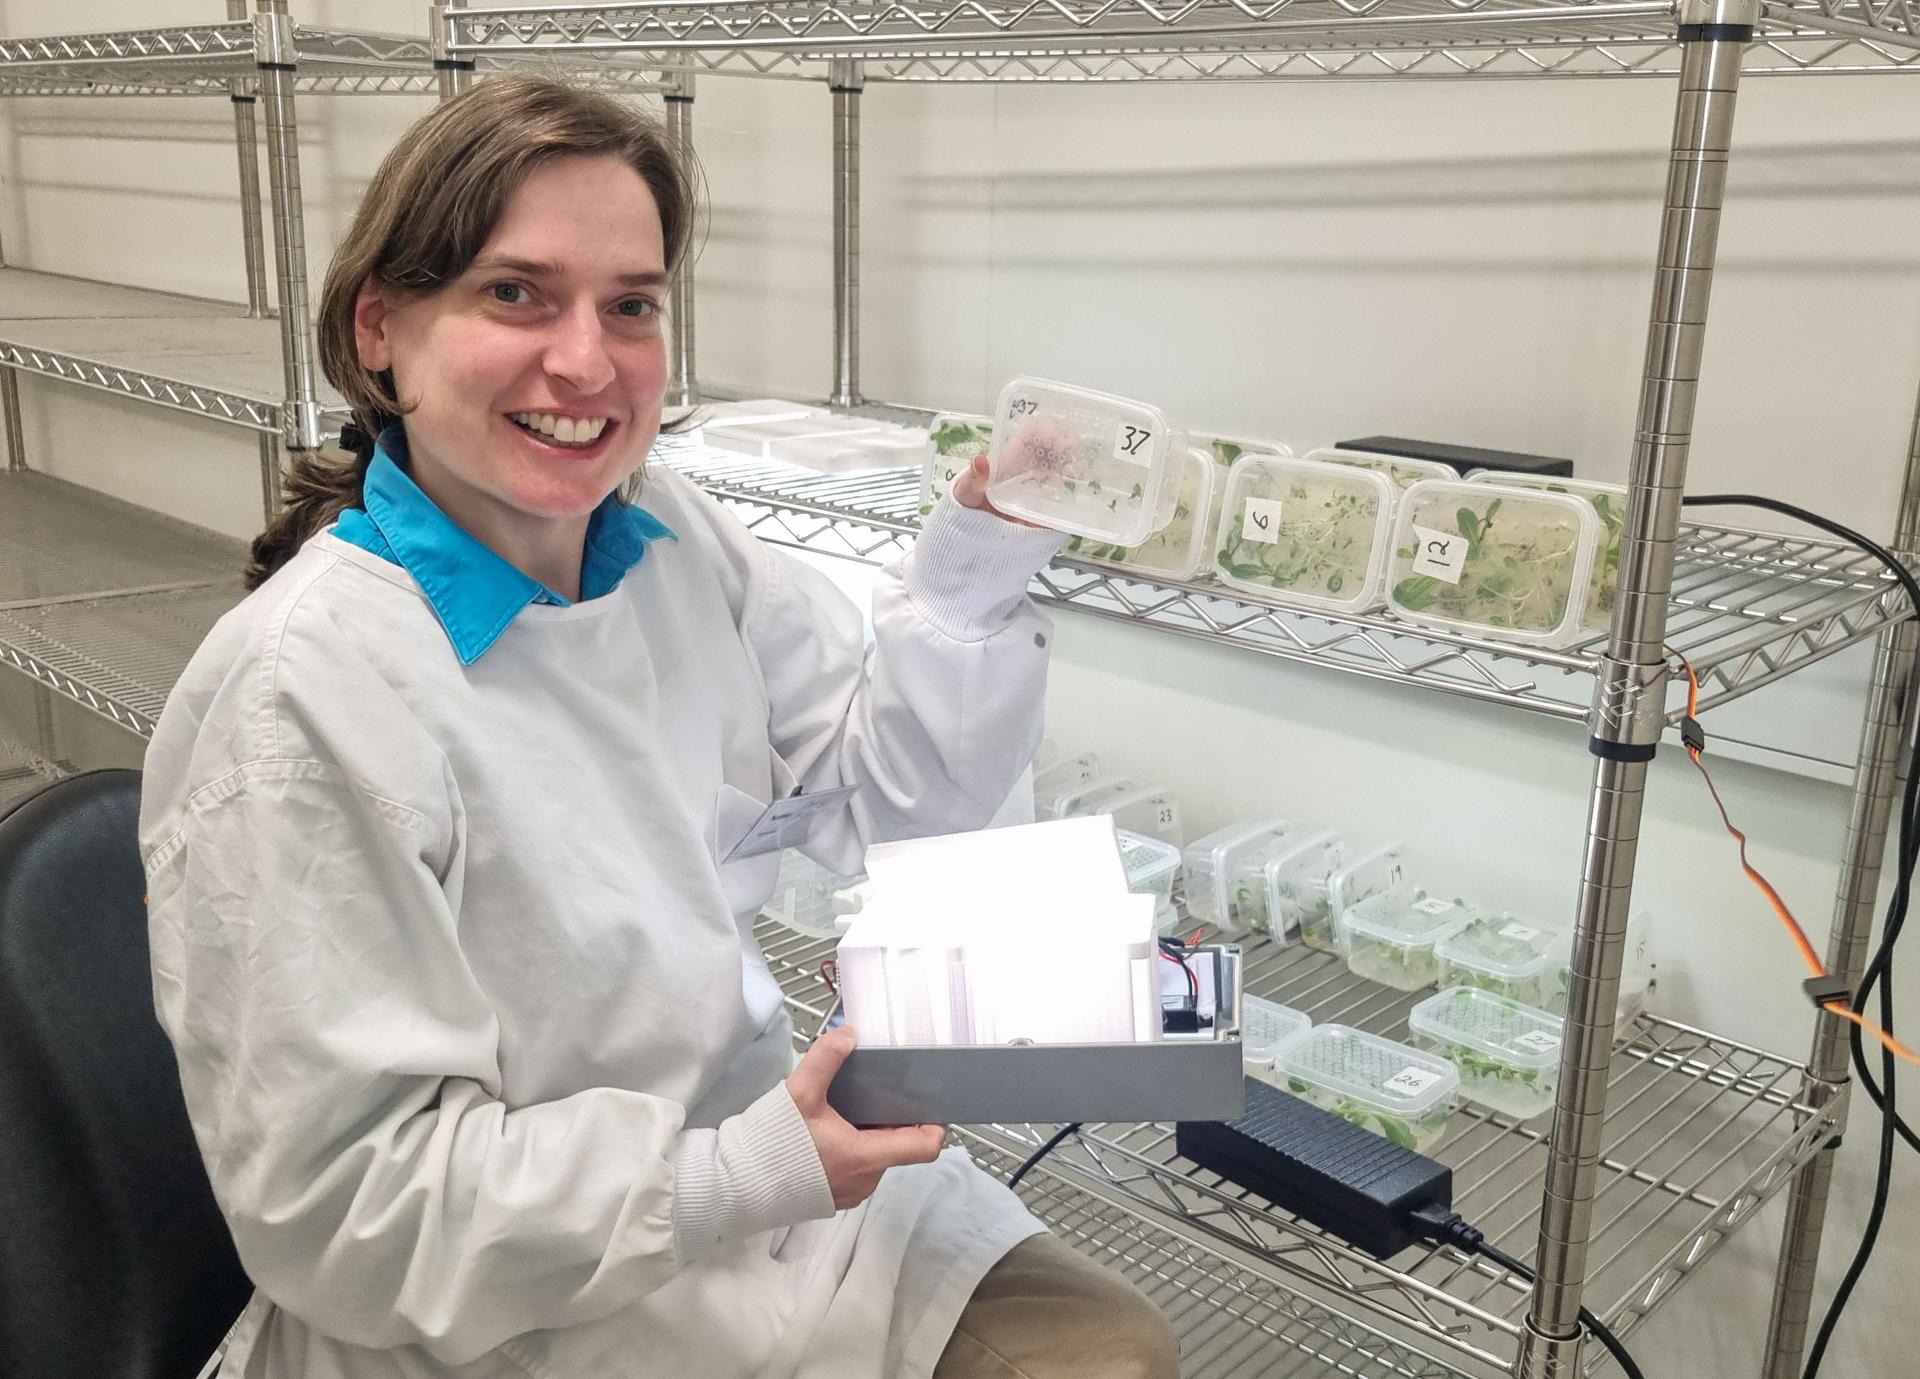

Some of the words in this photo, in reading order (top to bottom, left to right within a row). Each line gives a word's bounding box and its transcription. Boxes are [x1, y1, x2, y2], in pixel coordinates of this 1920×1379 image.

[1121, 425, 1151, 455] 37
[1252, 510, 1269, 530] 6
[1159, 808, 1172, 823] 23
[1390, 864, 1402, 885] 19
[1393, 1074, 1423, 1087] 26
